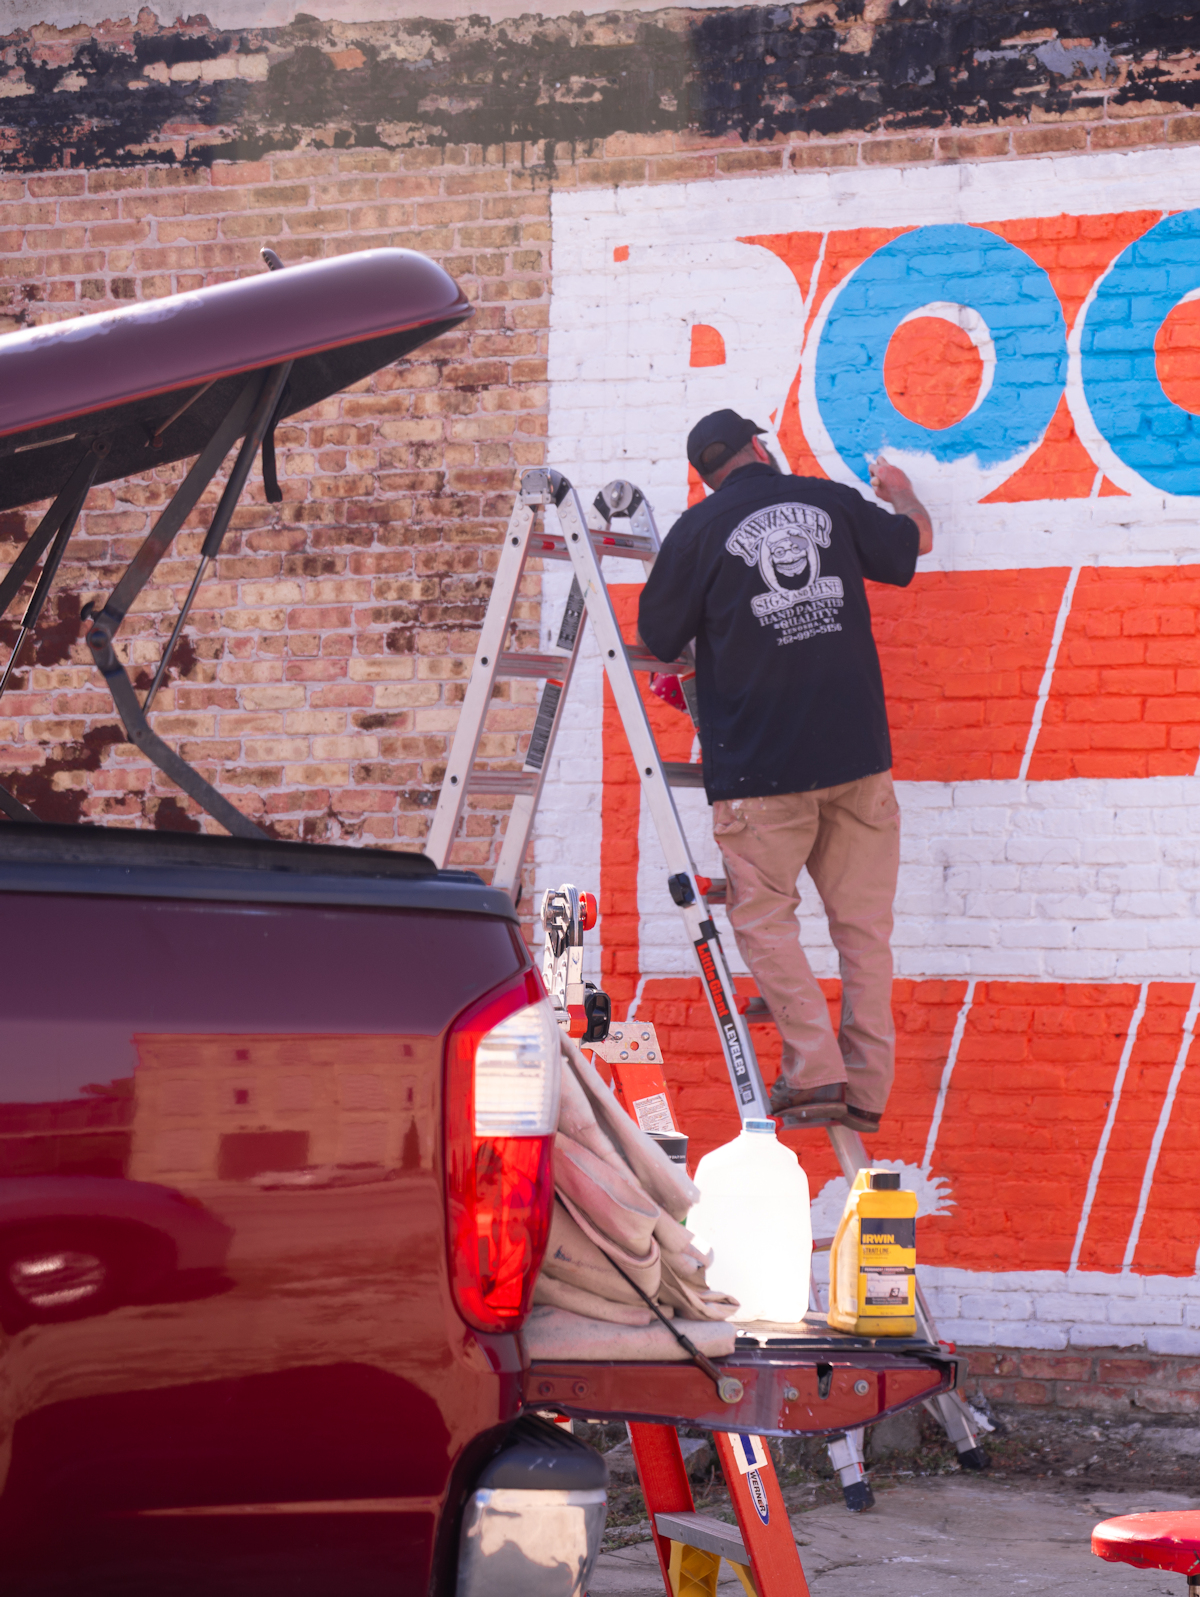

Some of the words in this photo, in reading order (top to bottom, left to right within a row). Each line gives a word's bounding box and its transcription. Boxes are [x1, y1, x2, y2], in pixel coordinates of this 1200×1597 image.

[755, 592, 791, 613] SIGN
[759, 608, 794, 627] HAND
[795, 598, 844, 615] PAINTED
[780, 608, 833, 629] QUALITY
[724, 1022, 746, 1076] LEVELER
[862, 1233, 895, 1244] IRWIN
[750, 1471, 766, 1512] WERNER
